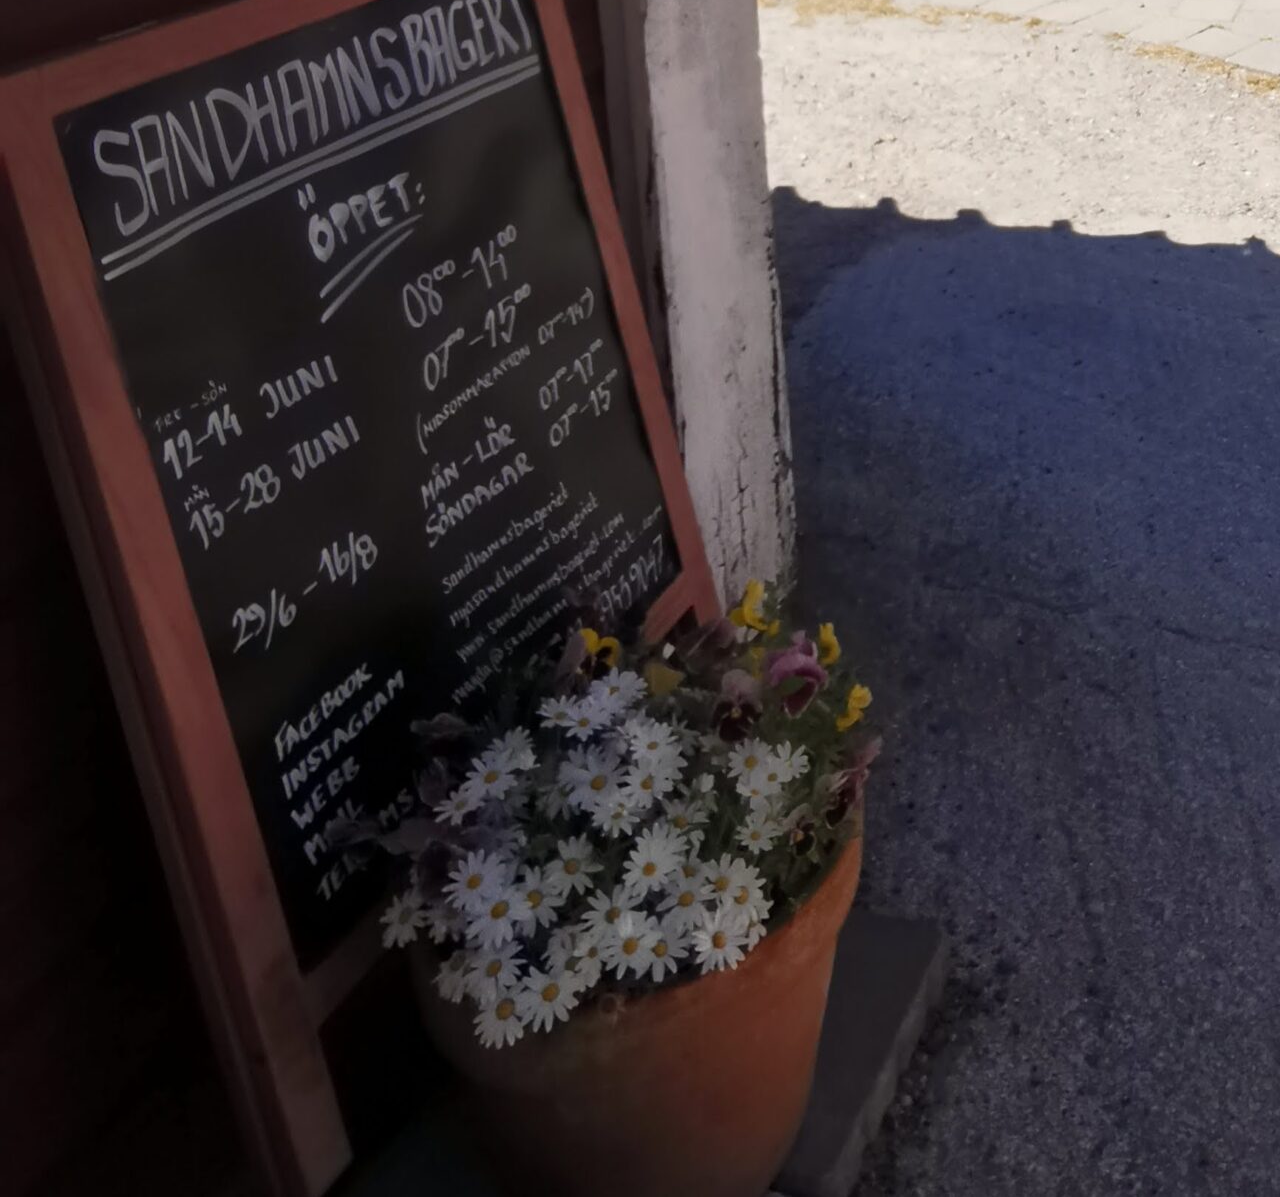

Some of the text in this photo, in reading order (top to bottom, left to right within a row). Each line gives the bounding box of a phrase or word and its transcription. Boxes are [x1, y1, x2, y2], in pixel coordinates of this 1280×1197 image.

[299, 173, 426, 262] ÖPPET:
[259, 355, 338, 419] JUNI
[288, 415, 360, 480] JUNI
[426, 452, 534, 548] SÖNDAGAR
[274, 662, 373, 762] FACEBOOK
[281, 669, 405, 801] INSTAGRAM
[290, 755, 360, 830] WEBB
